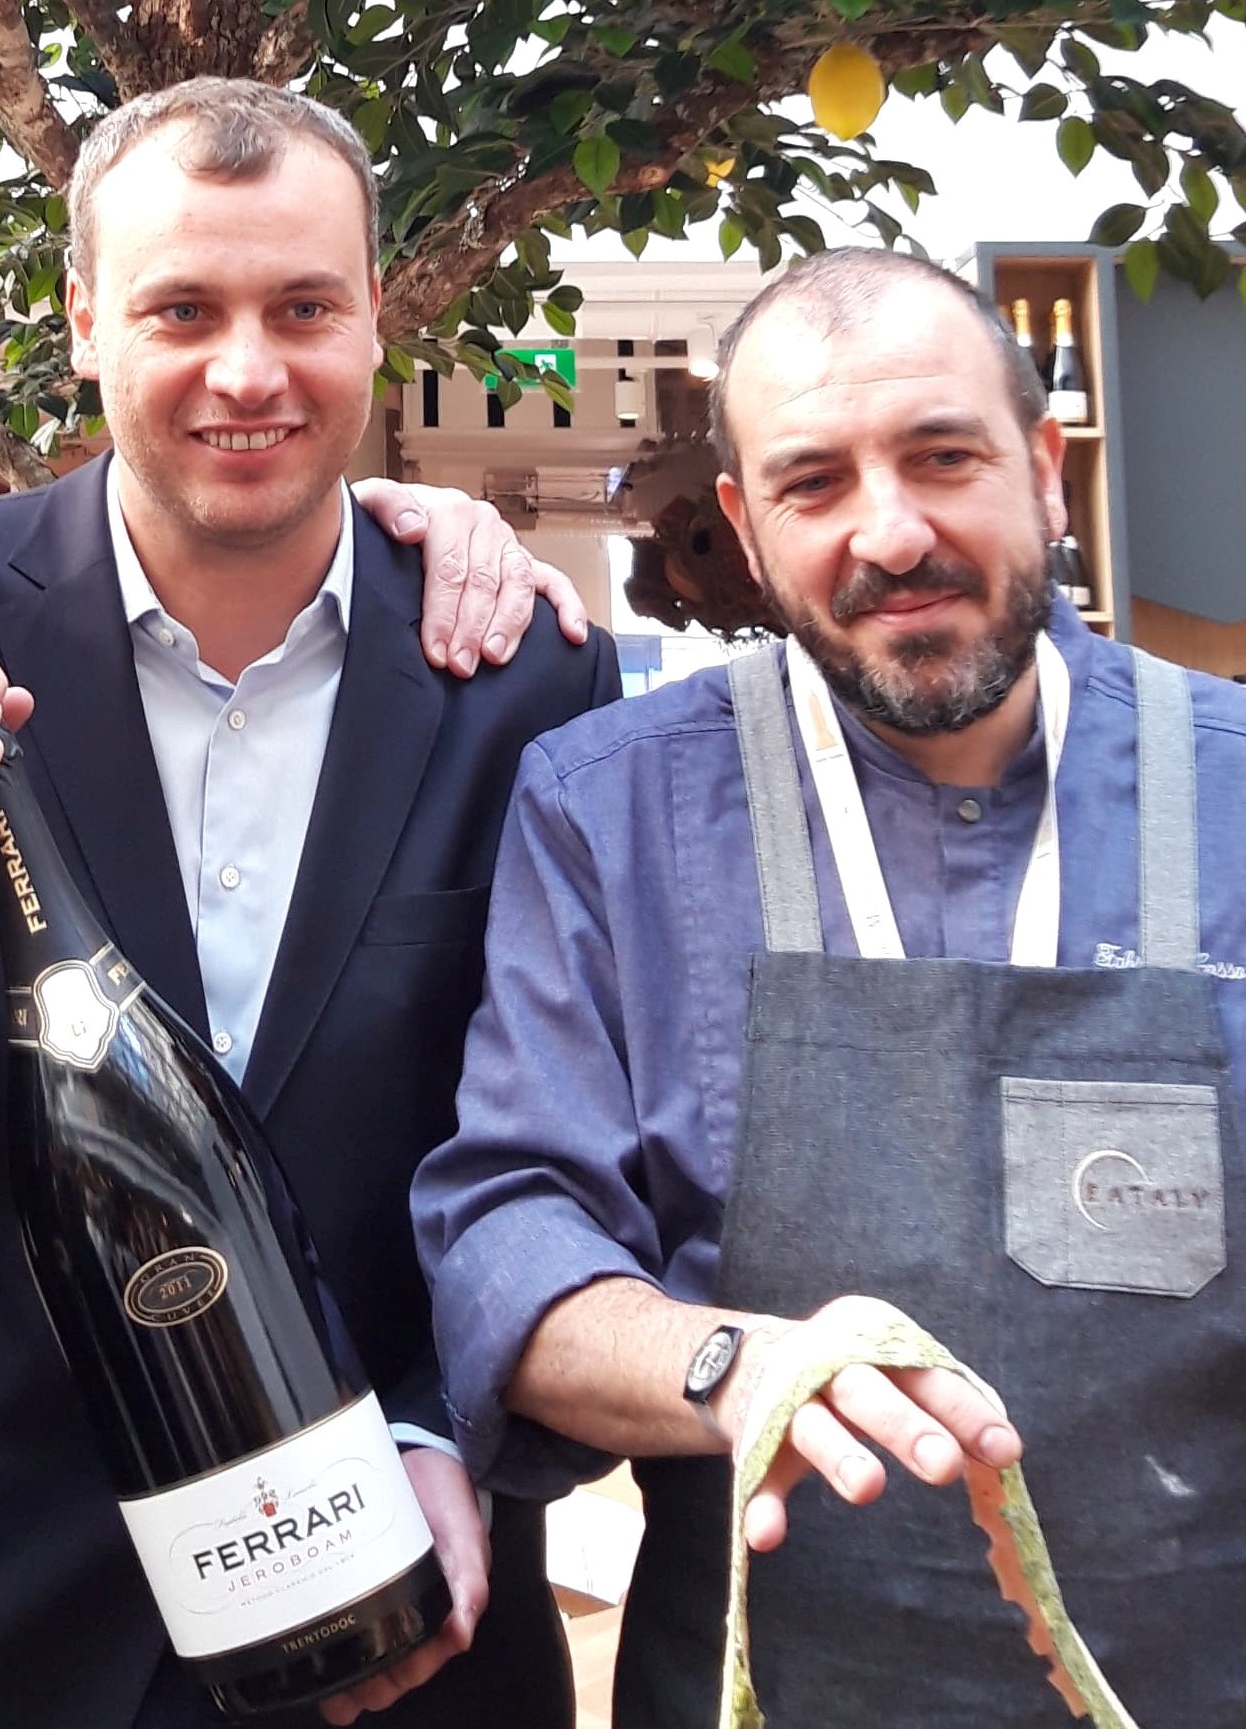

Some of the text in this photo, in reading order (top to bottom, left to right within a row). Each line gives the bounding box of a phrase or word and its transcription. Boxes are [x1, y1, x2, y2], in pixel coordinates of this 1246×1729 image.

[192, 1483, 366, 1580] FERRARI
[228, 1529, 352, 1592] JEROBOAM
[283, 1613, 357, 1653] TRENTODOC
